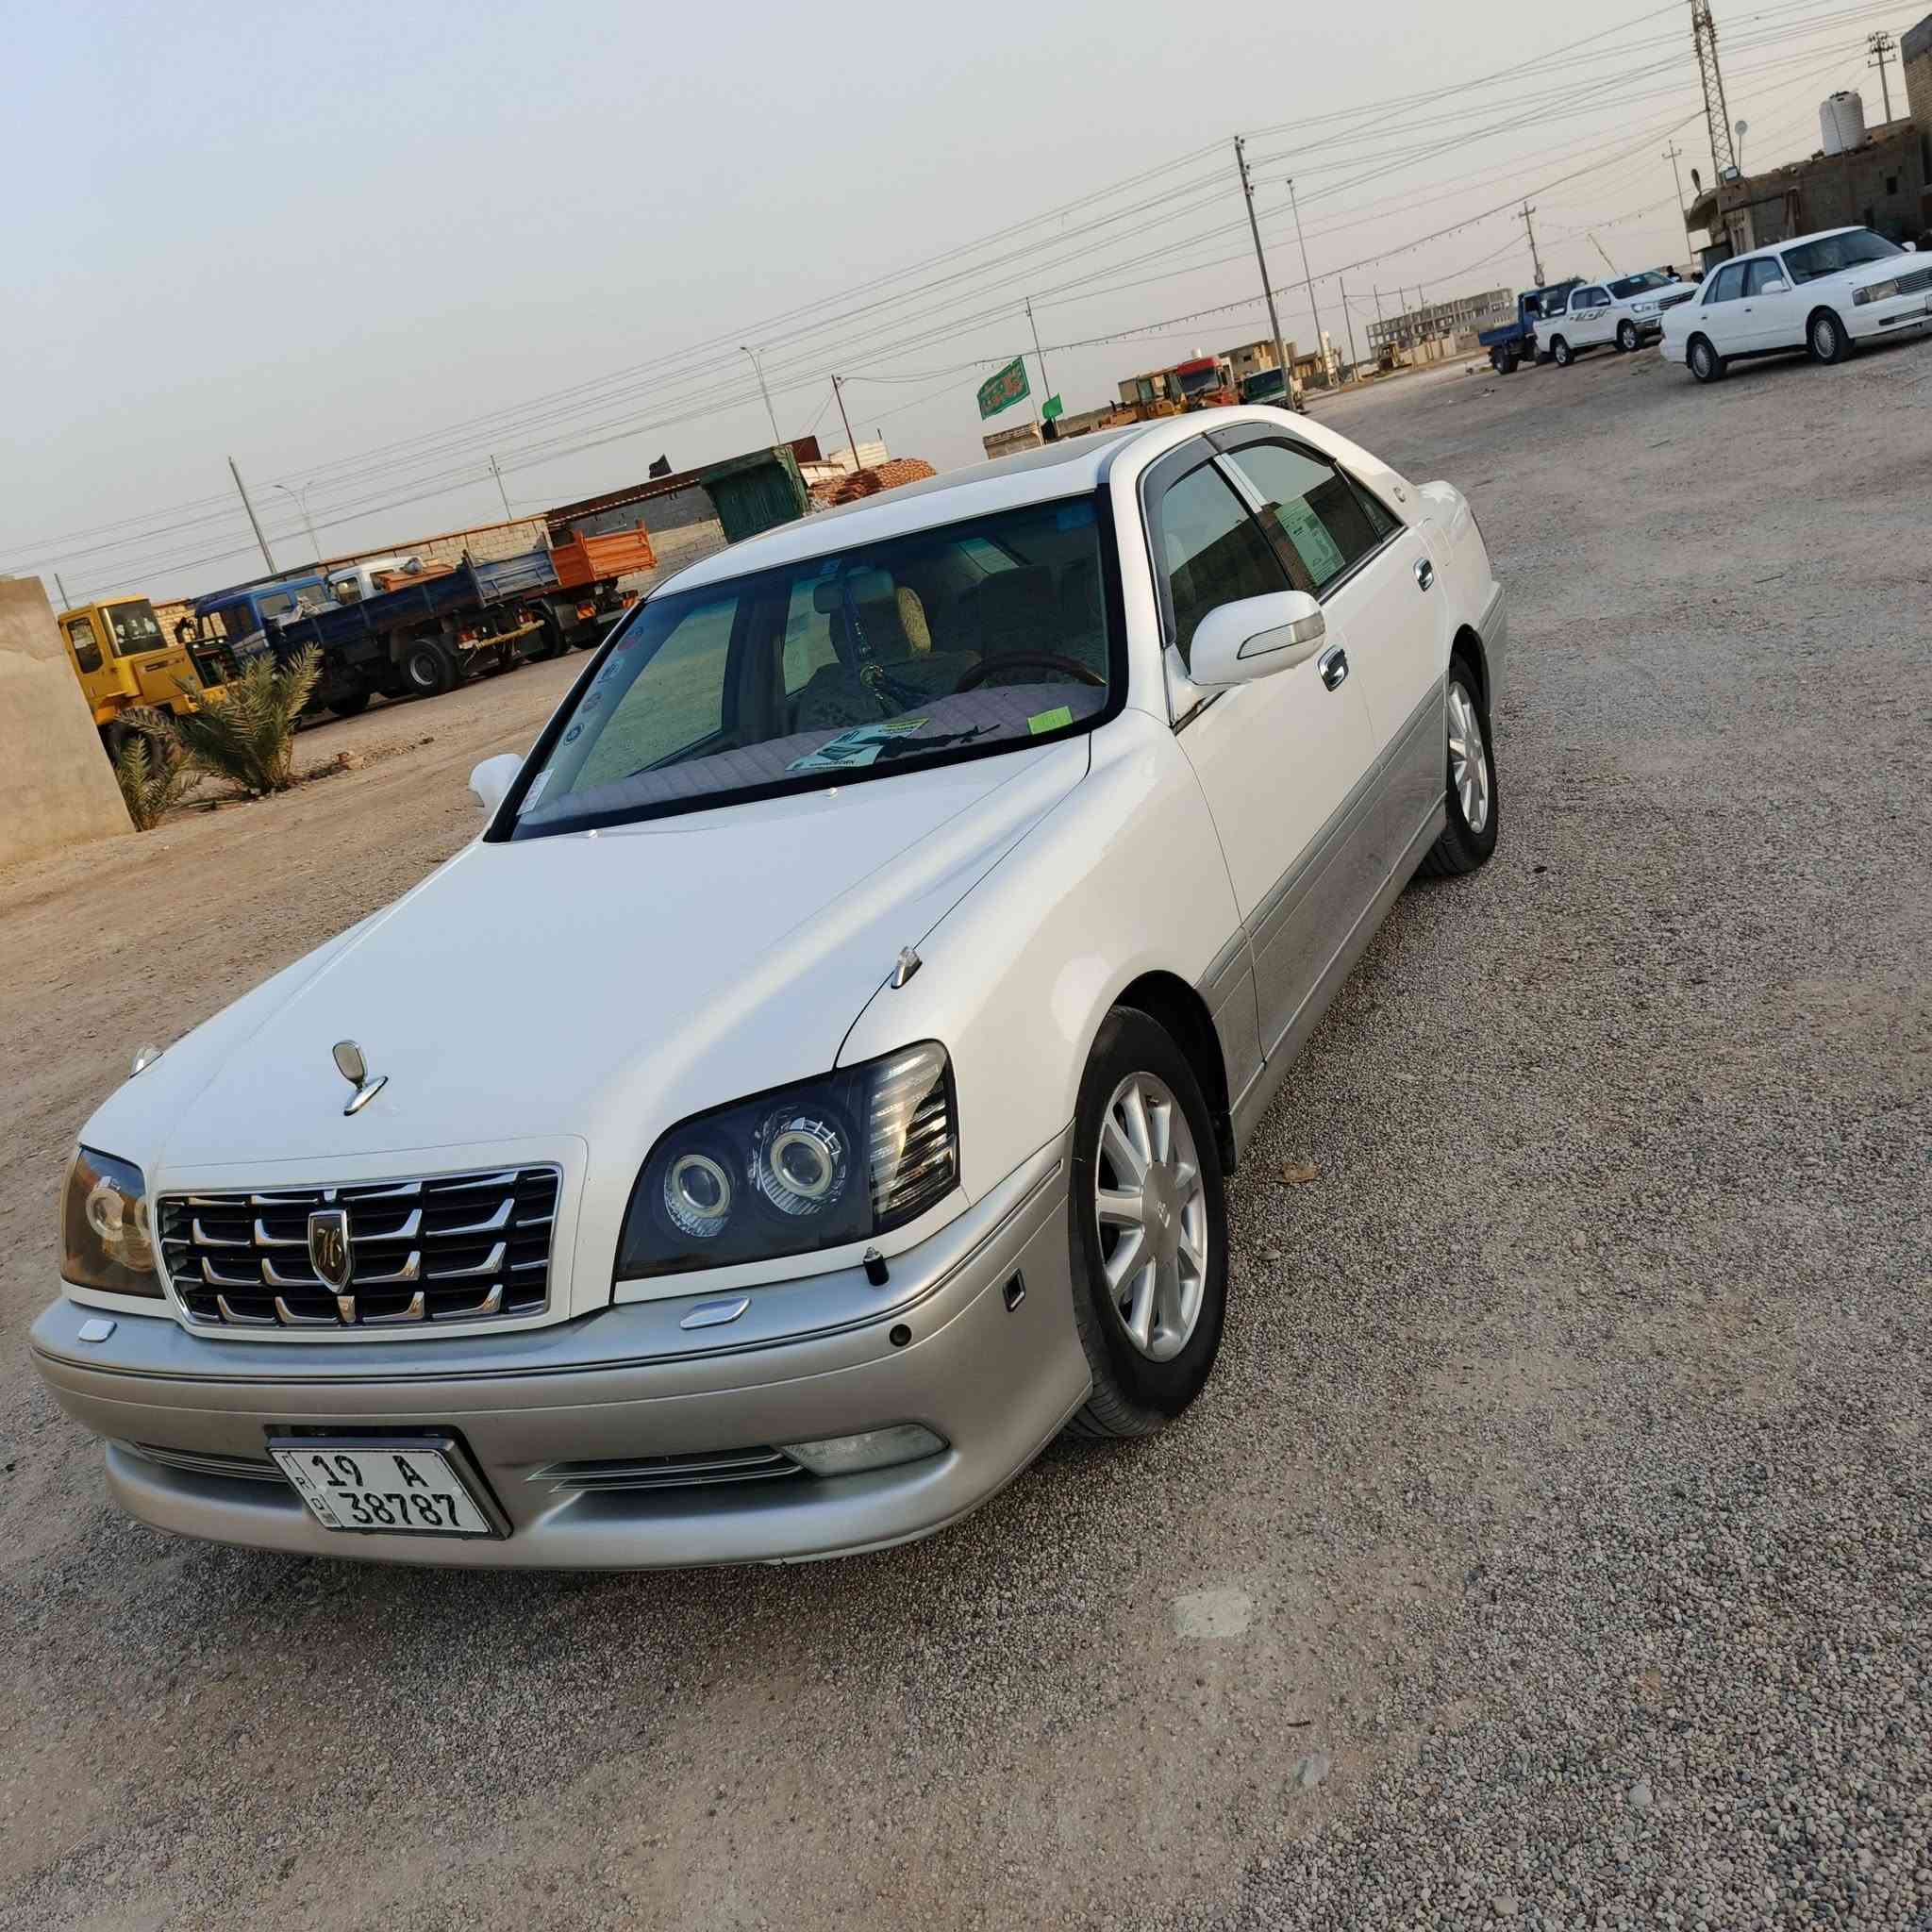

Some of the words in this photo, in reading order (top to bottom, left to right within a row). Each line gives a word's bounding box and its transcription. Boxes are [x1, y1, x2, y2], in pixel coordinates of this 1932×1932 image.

[311, 1455, 364, 1488] 19
[392, 1455, 430, 1488] A
[338, 1491, 461, 1527] 38787
